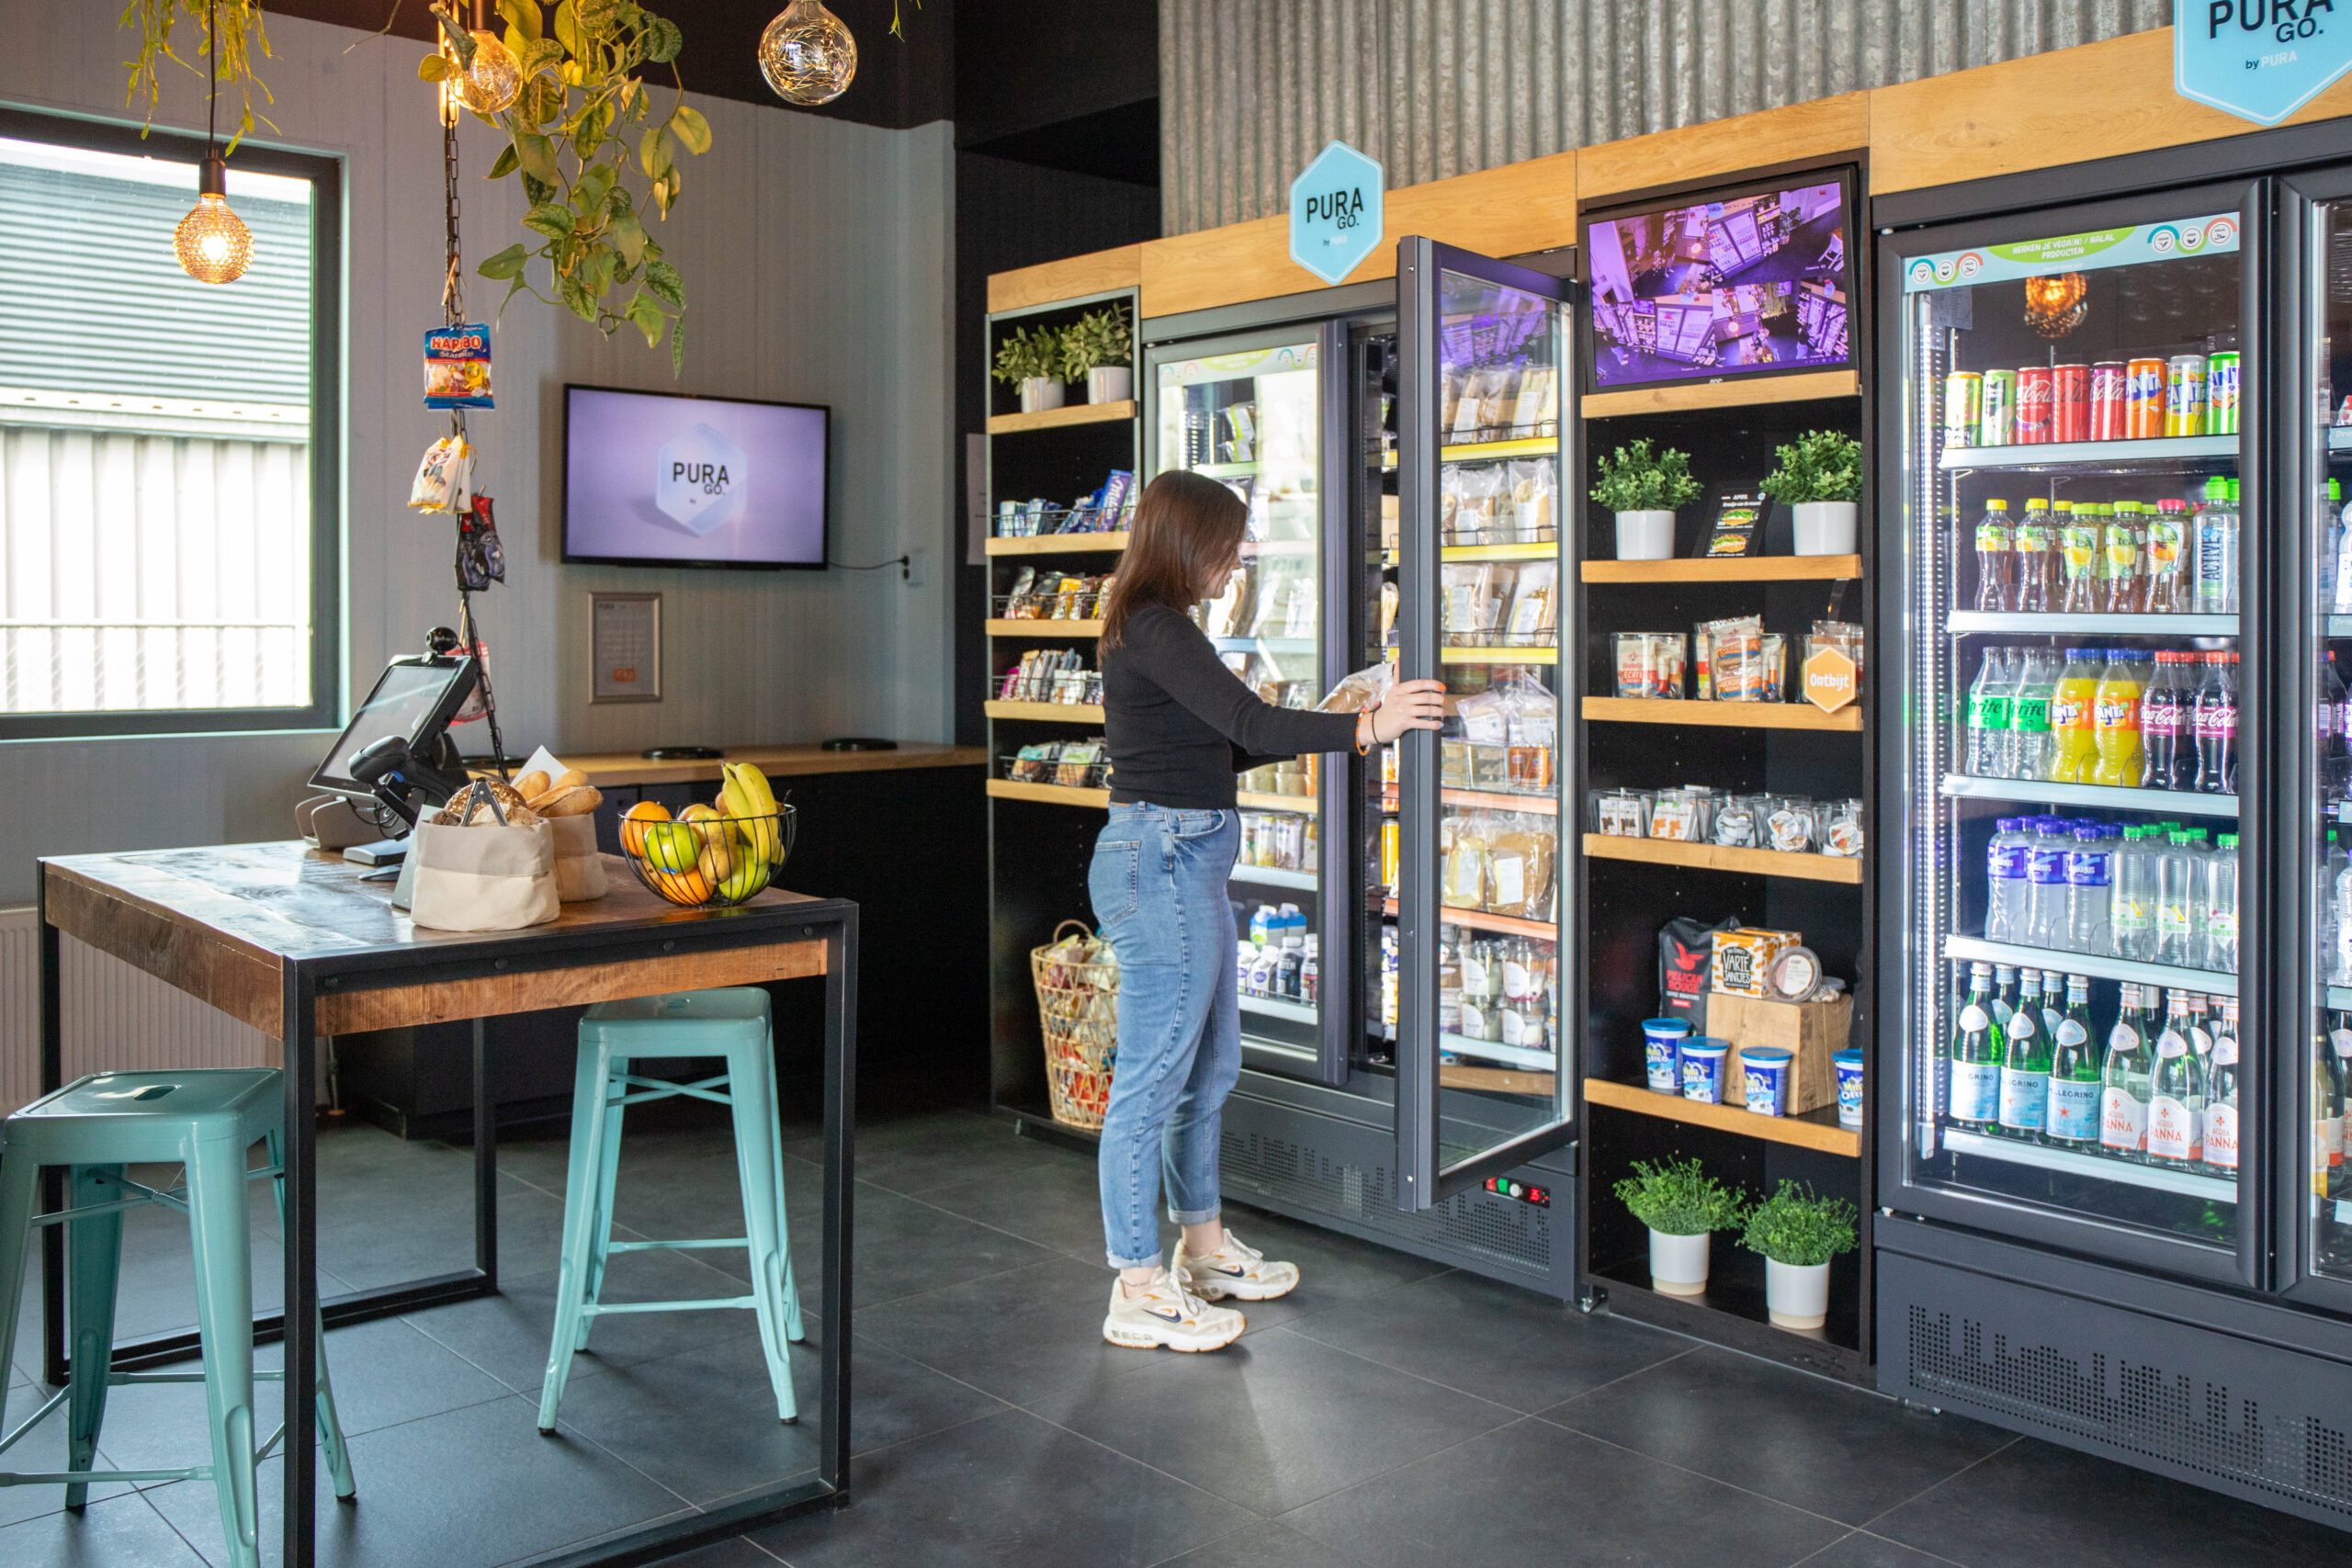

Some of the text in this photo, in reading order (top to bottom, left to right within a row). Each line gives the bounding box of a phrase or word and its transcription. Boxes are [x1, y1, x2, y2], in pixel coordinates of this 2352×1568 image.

[2276, 17, 2324, 43] GO.
[2245, 51, 2298, 70] by PURA
[1306, 186, 1363, 223] PURA
[1337, 214, 1360, 230] GO.
[2041, 246, 2085, 259] PRODUCTEN
[673, 462, 729, 486] PURA
[1105, 478, 1125, 520] Milka
[2200, 536, 2221, 581] ACTIVE
[1810, 672, 1849, 692] Ontbijt
[1666, 969, 1703, 984] PELICAN
[1668, 980, 1699, 994] ROUGE
[2150, 1124, 2183, 1142] PANNA
[2156, 1120, 2174, 1128] ACQUA
[2211, 1127, 2231, 1135] ACQUA
